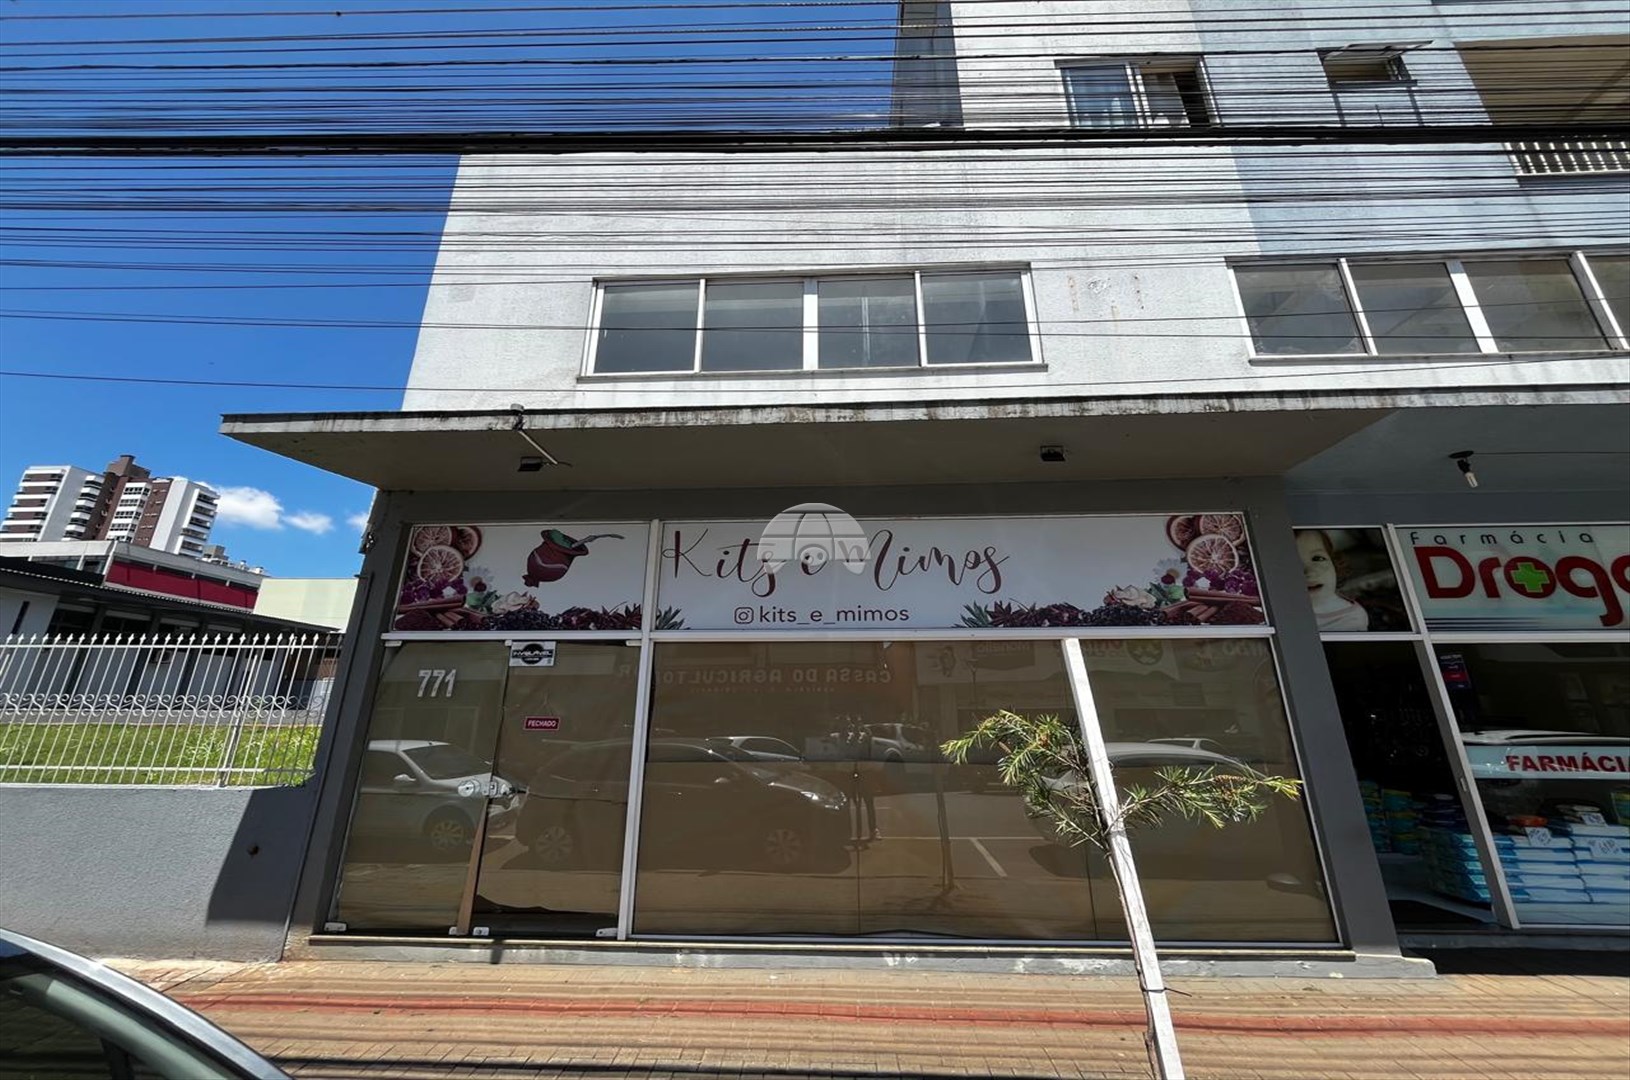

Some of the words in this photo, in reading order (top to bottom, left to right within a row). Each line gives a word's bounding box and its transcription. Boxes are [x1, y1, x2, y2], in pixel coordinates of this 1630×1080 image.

[1410, 531, 1595, 545] Farmácia
[661, 528, 787, 597] Kits
[837, 529, 1010, 594] Mimos
[759, 605, 909, 625] kits_e_mimos
[417, 669, 456, 698] 771
[527, 719, 557, 728] FECHADO
[1506, 752, 1630, 773] FARMÁCI
